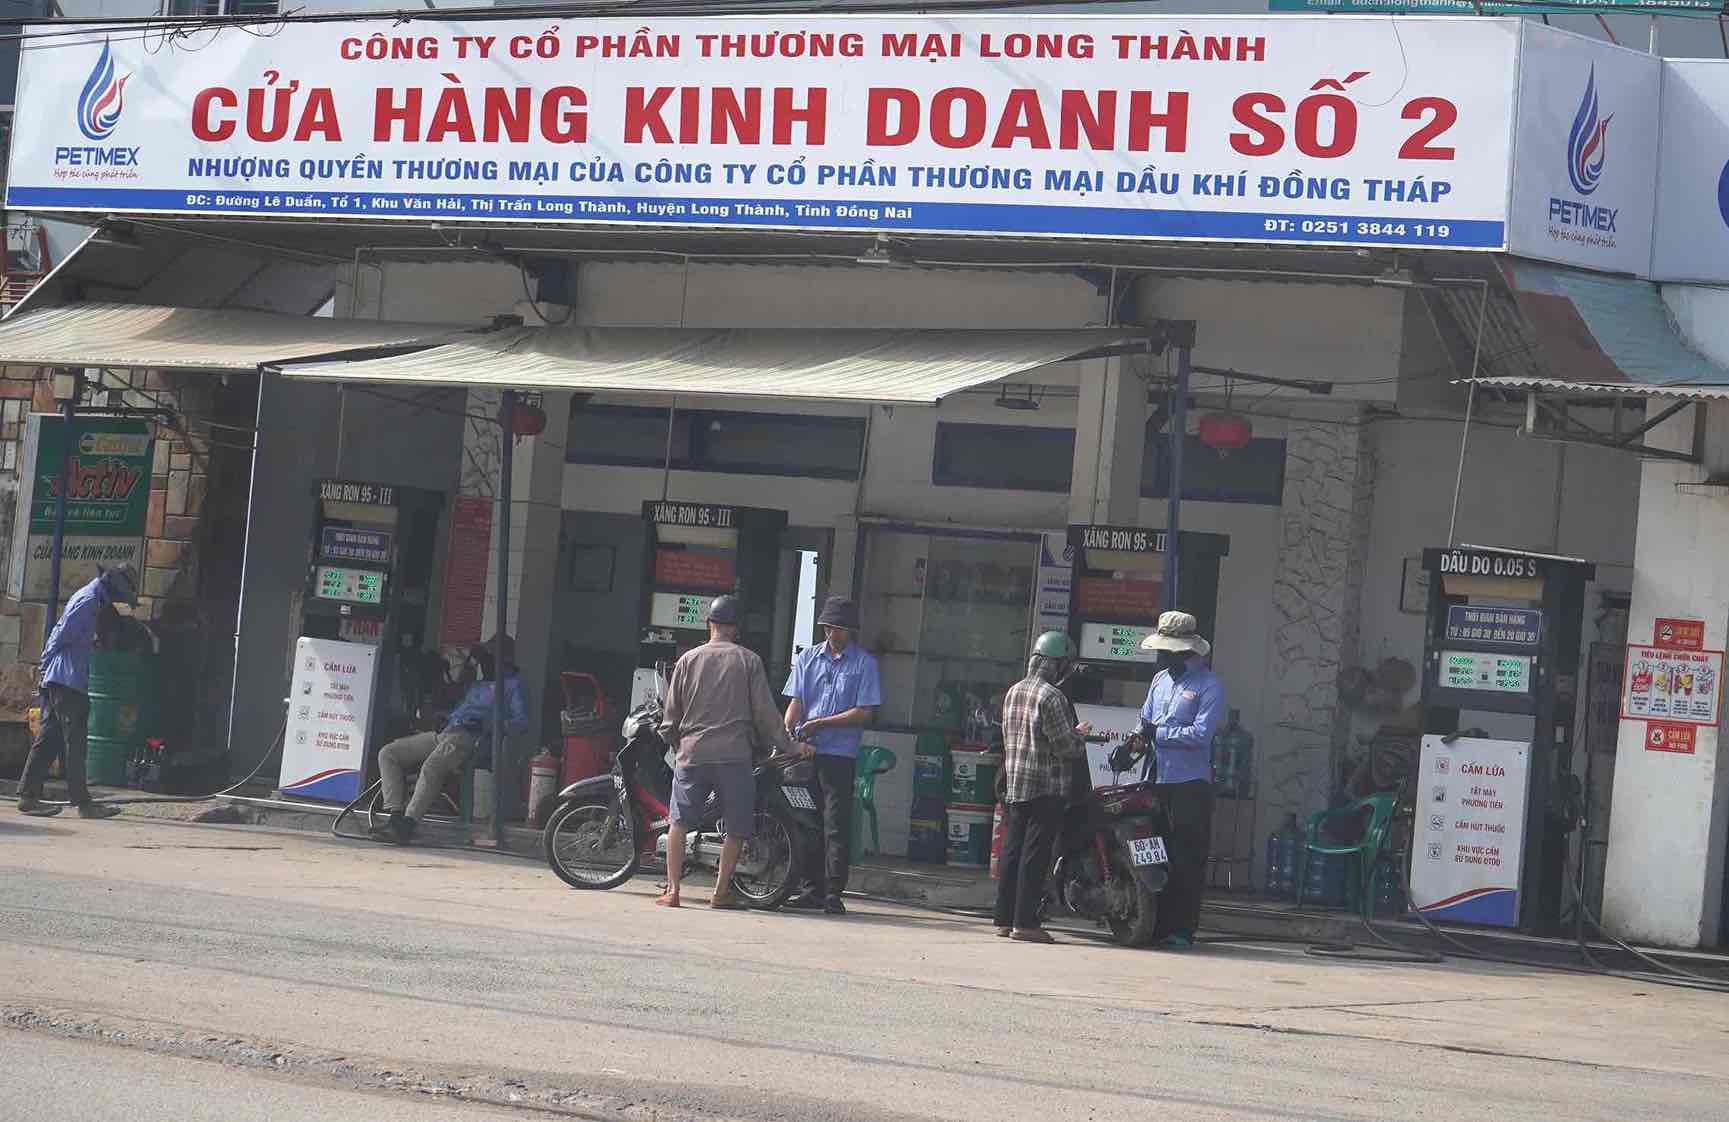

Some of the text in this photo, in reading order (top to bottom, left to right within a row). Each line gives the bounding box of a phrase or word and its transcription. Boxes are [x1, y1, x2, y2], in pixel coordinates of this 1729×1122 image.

[341, 25, 1265, 63] CÔNG TY CỔ PHẦN THƯƠNG MẠI LONG THÀNH
[191, 70, 1458, 160] CỬA HÀNG KINH DOANH SỐ 2
[55, 146, 140, 166] PETIMEX
[187, 153, 1452, 203] NHƯỢNG QUYỀN THƯƠNG MẠI CỦA CÔNG TY CỔ PHẦN THƯƠNG MẠI DẦU KHÍ ĐỒNG THÁP
[186, 195, 211, 205] ĐC:
[215, 195, 260, 208] Đường
[264, 196, 281, 207] Lê
[353, 198, 367, 210] 1,
[371, 198, 398, 209] Khu
[402, 197, 431, 210] Văn
[471, 199, 493, 213] Thị
[498, 198, 531, 211] Trấn
[537, 200, 573, 214] Long
[578, 201, 631, 215] Thành,
[636, 202, 686, 217] Huyện
[691, 203, 729, 217] Long
[734, 204, 790, 218] Thành,
[884, 207, 912, 219] Nai
[1549, 198, 1618, 232] PETIMEX
[1264, 219, 1450, 238] ĐT: 0251 3844 119
[343, 484, 360, 501] RON
[361, 487, 372, 502] 95
[379, 487, 393, 505] III
[653, 502, 677, 523] XĂNG
[678, 505, 696, 524] RON
[698, 508, 709, 526] 95
[717, 508, 732, 527] III
[1082, 526, 1109, 548] XĂNG
[1111, 530, 1131, 550] RON
[1133, 531, 1147, 551] 95
[1440, 550, 1537, 577] DẦU DO 0.05 S
